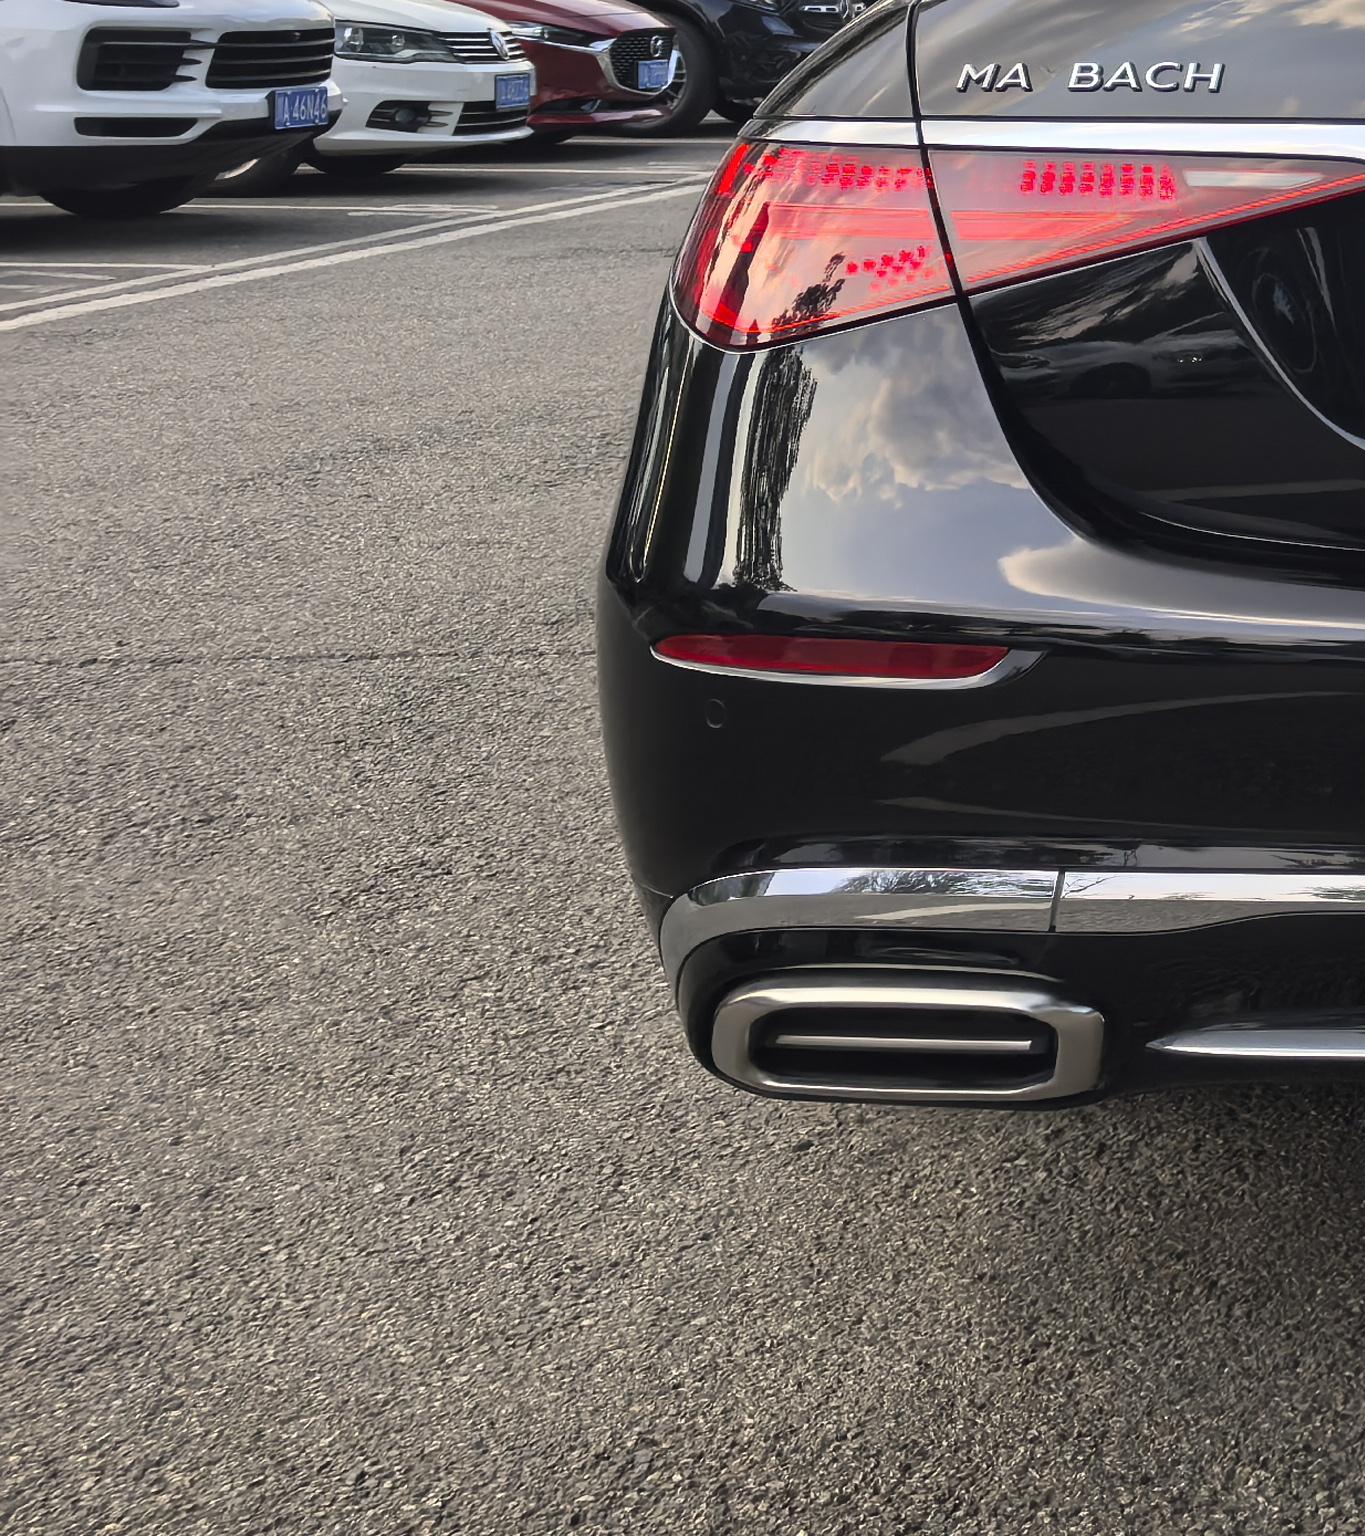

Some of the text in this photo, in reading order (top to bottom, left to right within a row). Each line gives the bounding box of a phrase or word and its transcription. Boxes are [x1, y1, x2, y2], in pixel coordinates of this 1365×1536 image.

[956, 62, 1226, 93] MA BACH
[278, 93, 327, 124] A·46N46
